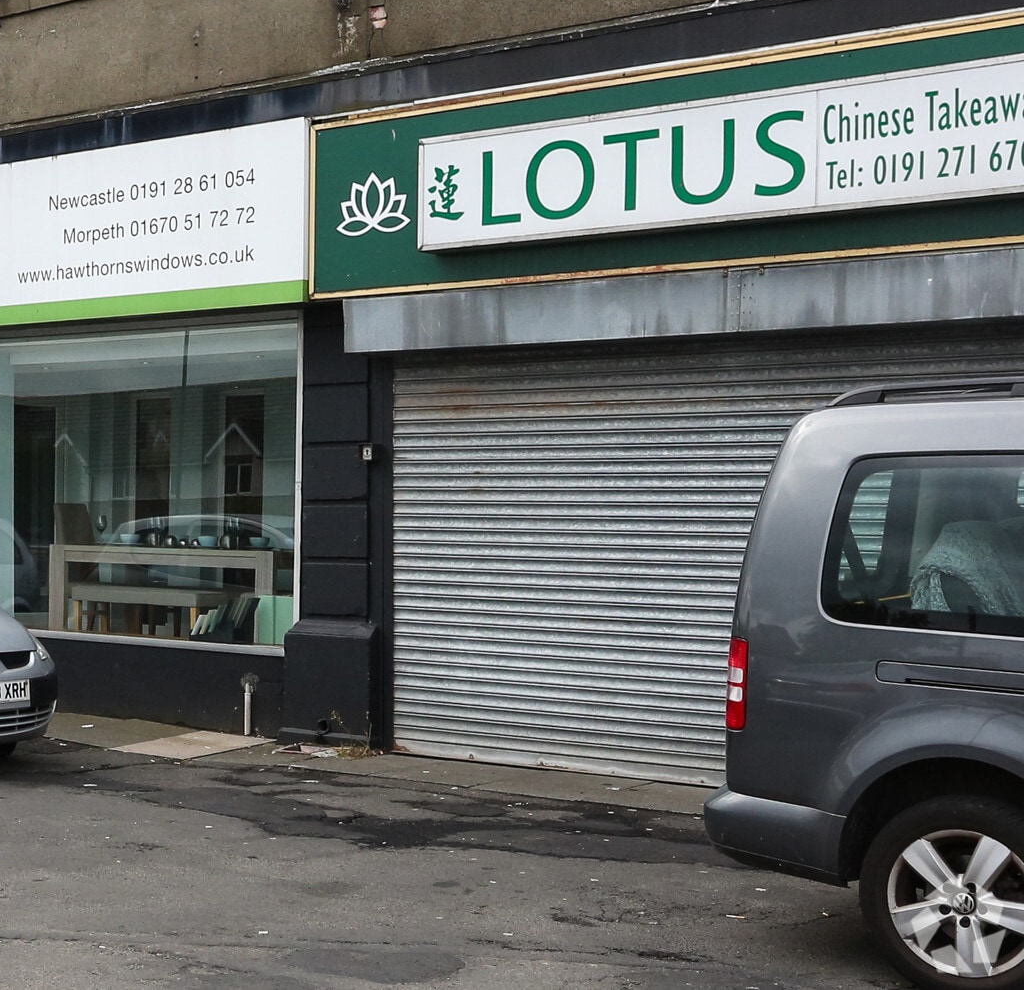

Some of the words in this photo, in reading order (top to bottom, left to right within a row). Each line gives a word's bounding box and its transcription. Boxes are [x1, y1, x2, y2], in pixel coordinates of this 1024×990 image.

[823, 101, 914, 145] Chinese
[925, 87, 1024, 131] Takeaw
[481, 109, 807, 226] LOTUS
[825, 159, 863, 190] Tel:
[873, 150, 925, 185] 0191
[936, 144, 975, 178] 271
[48, 187, 125, 211] Newcastle
[130, 180, 166, 201] 0191
[173, 177, 193, 195] 28
[199, 173, 217, 192] 61
[224, 168, 256, 188] 054
[428, 164, 464, 222] 蓮
[63, 222, 125, 245] Morpeth
[130, 215, 178, 237] 01670
[183, 212, 202, 231] 51
[210, 209, 229, 227] 72
[236, 206, 255, 225] 72
[17, 244, 254, 284] www.hawthornswindows.co.uk
[4, 682, 26, 699] XRH
